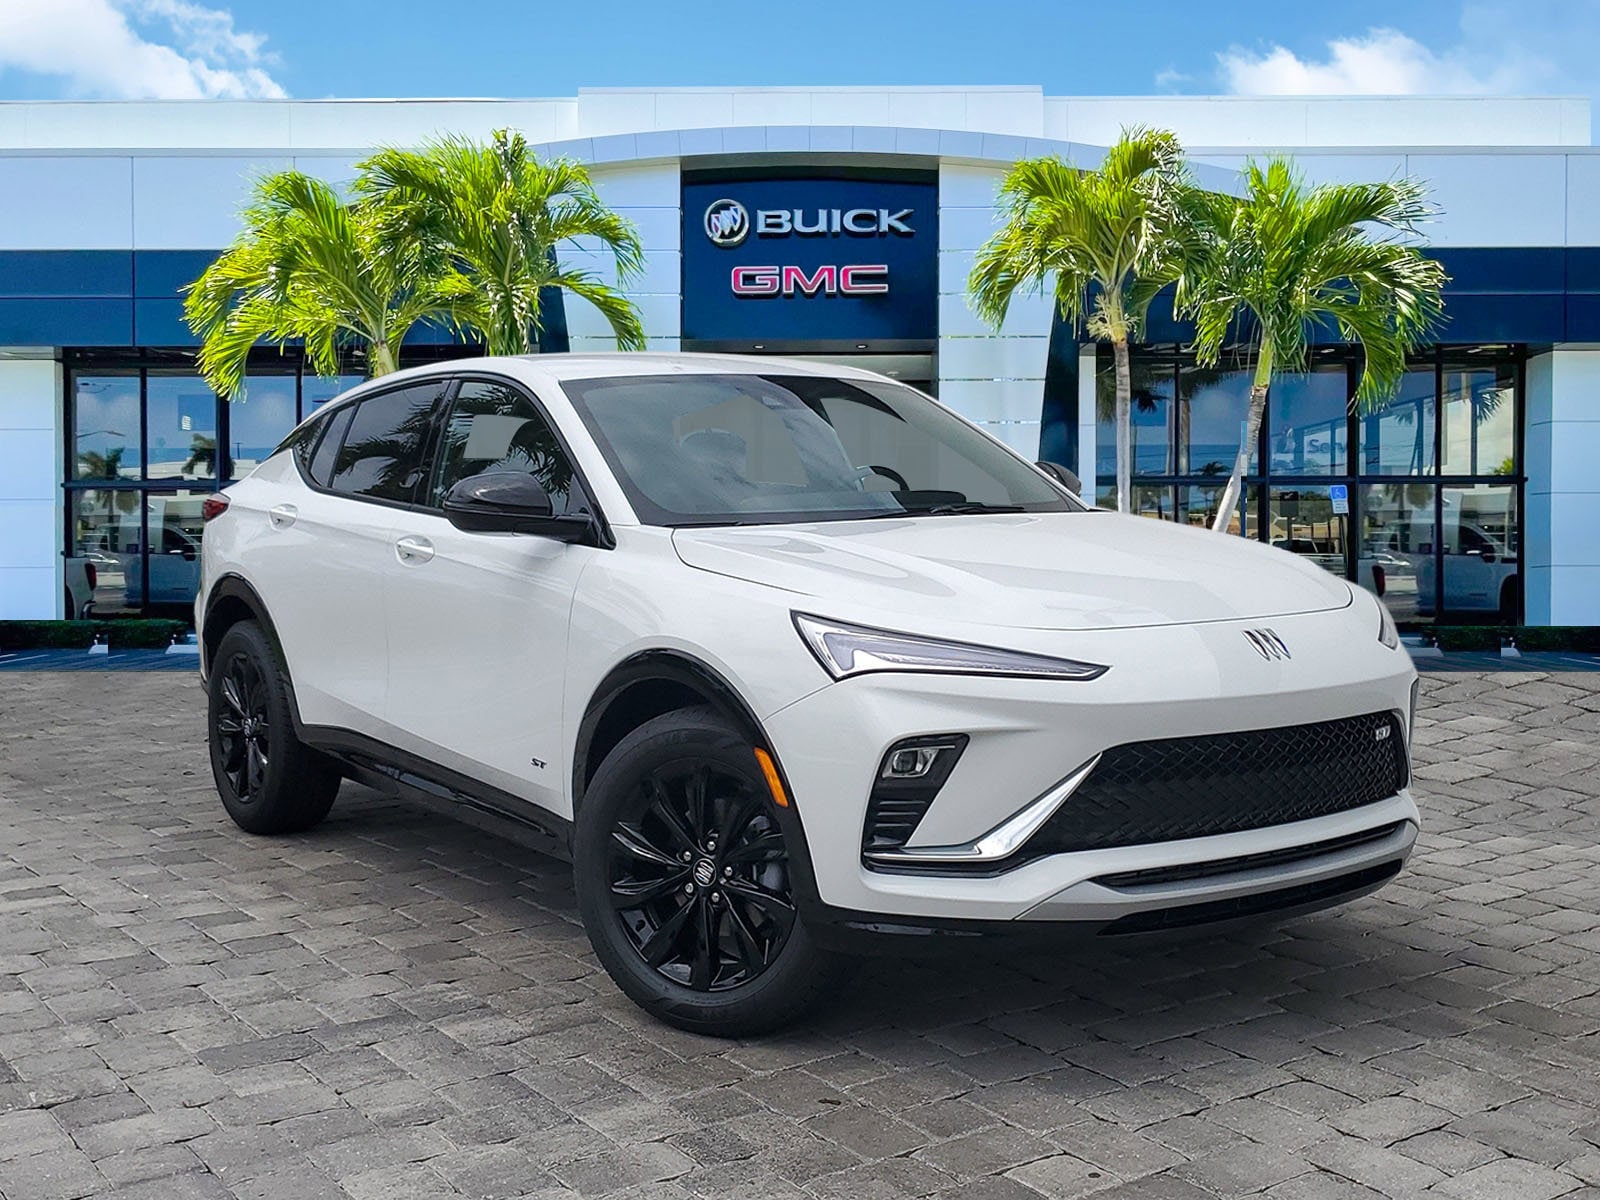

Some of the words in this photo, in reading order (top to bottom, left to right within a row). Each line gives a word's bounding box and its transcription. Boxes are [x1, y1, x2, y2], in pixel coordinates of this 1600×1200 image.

[756, 208, 916, 233] BUICK
[731, 264, 889, 294] GMC
[530, 758, 547, 769] ST
